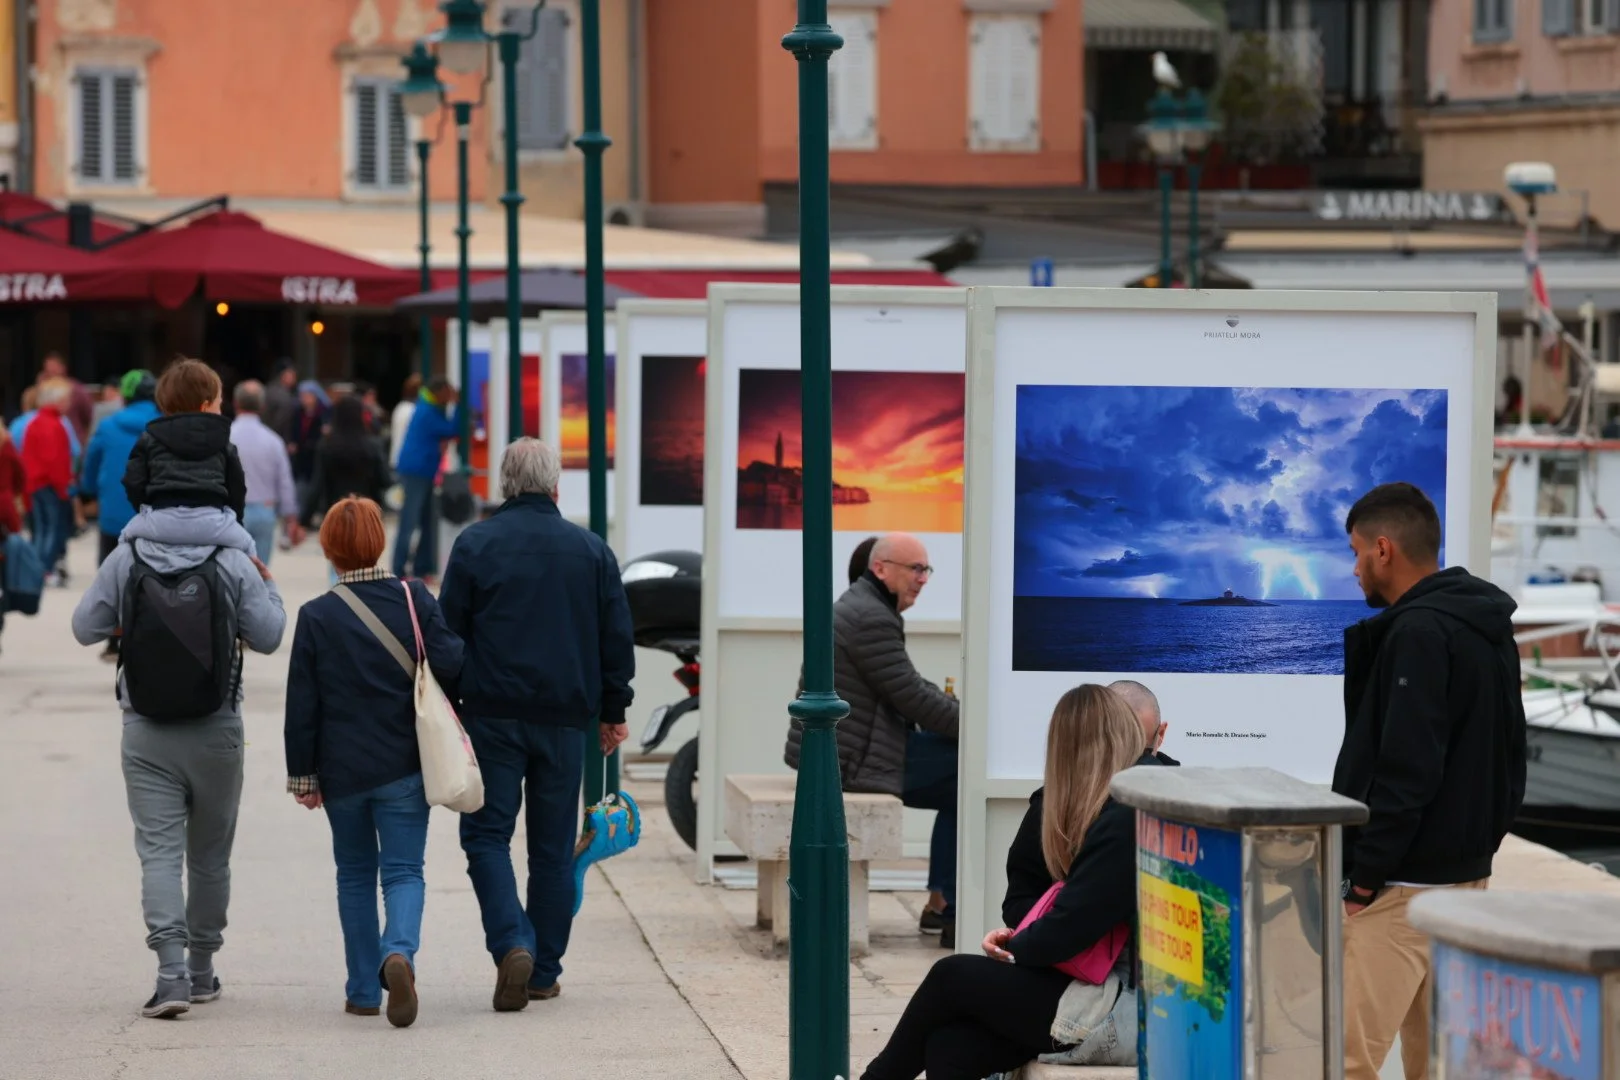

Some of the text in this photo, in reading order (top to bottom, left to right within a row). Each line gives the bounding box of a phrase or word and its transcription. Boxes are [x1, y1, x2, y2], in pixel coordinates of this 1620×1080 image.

[1348, 190, 1464, 219] MARINA
[282, 276, 357, 304] ISTRA
[1171, 902, 1199, 933] TOUR
[1166, 933, 1193, 964] TOUR
